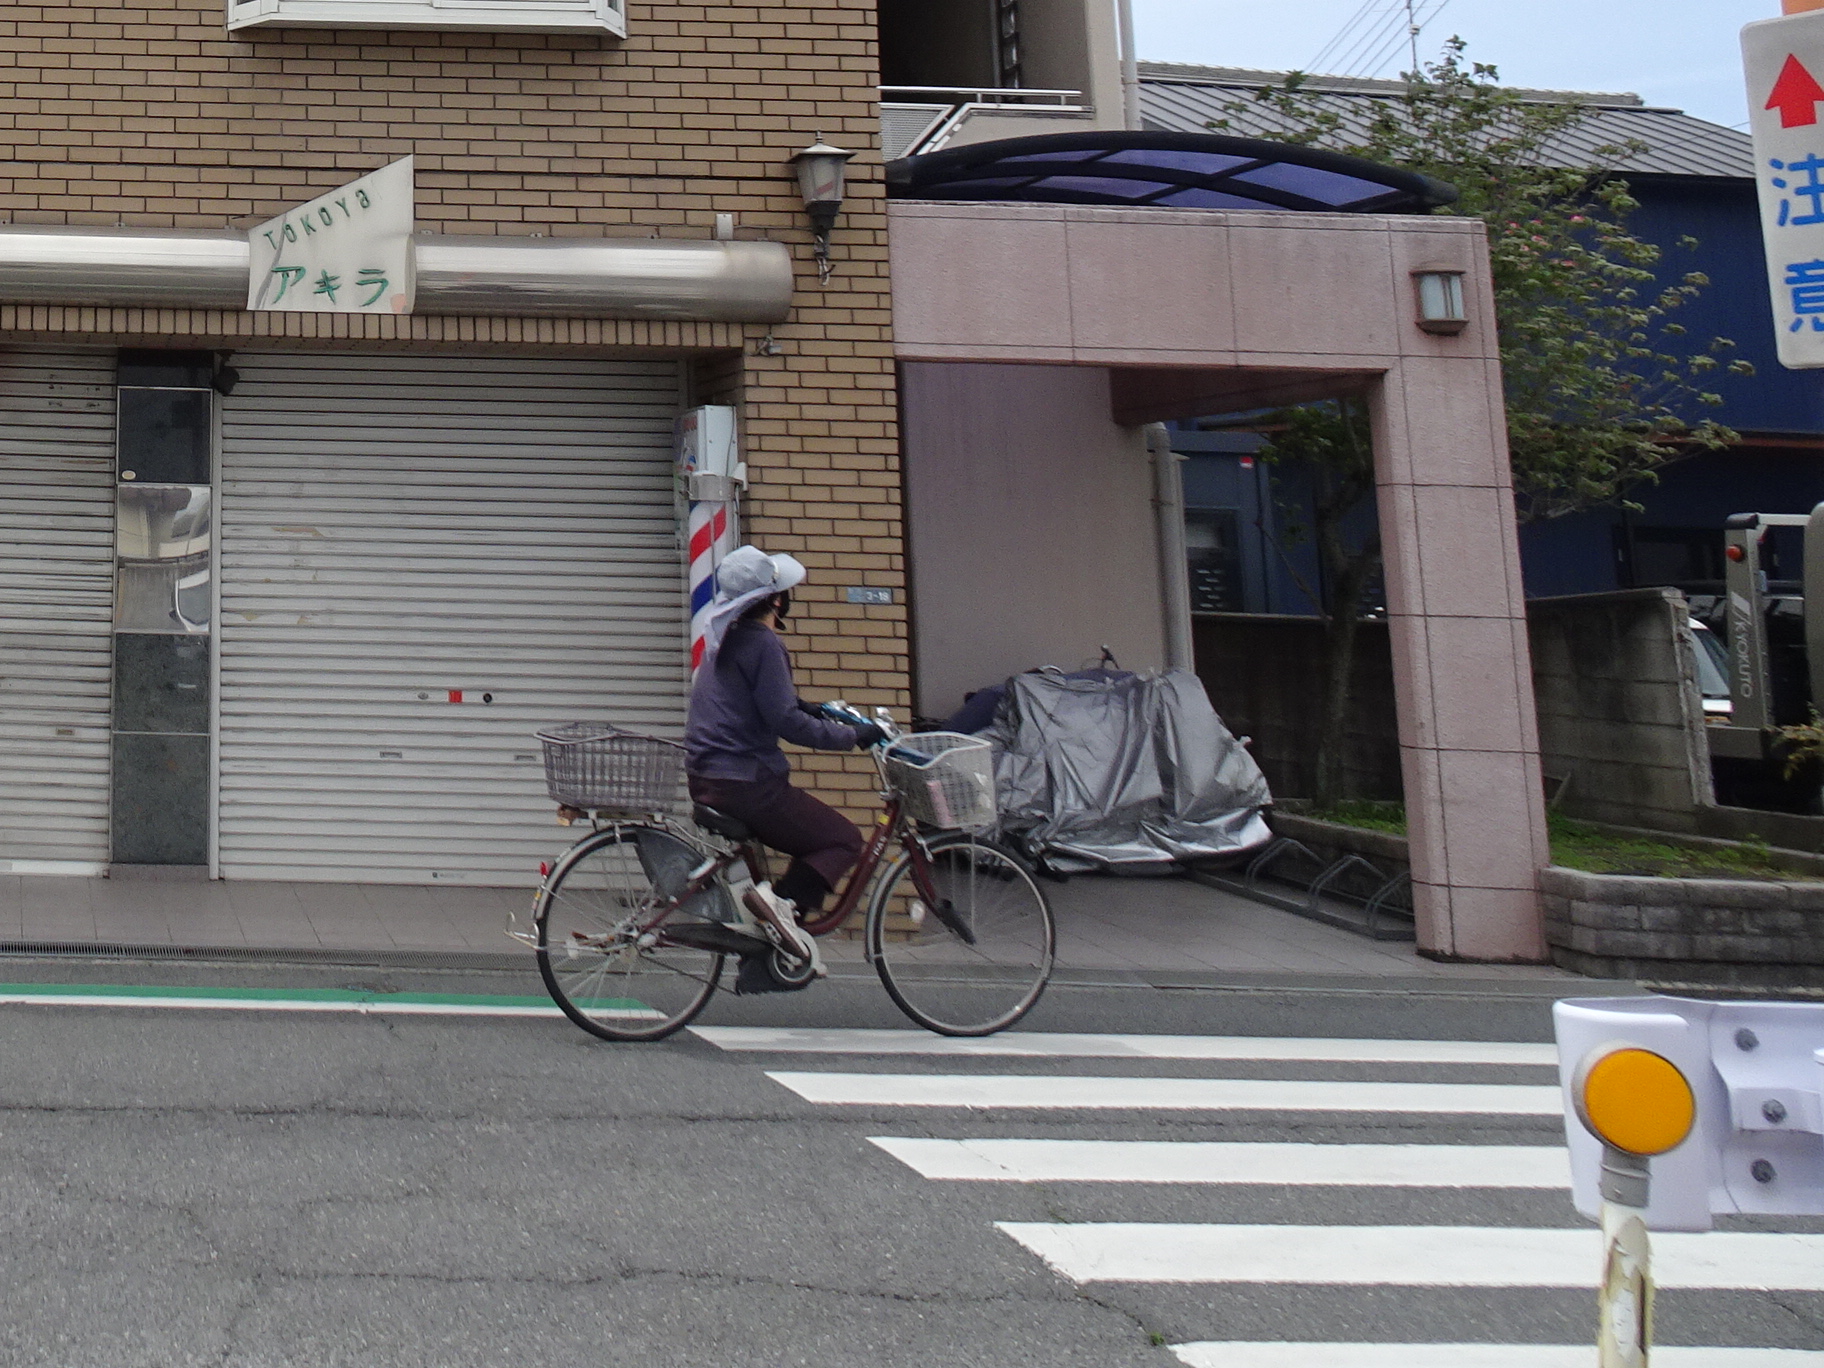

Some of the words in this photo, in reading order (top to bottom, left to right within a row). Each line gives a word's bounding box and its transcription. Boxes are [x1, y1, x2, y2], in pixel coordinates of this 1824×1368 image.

[271, 266, 389, 307] アキラ
[1734, 620, 1753, 699] KYOKUTO
